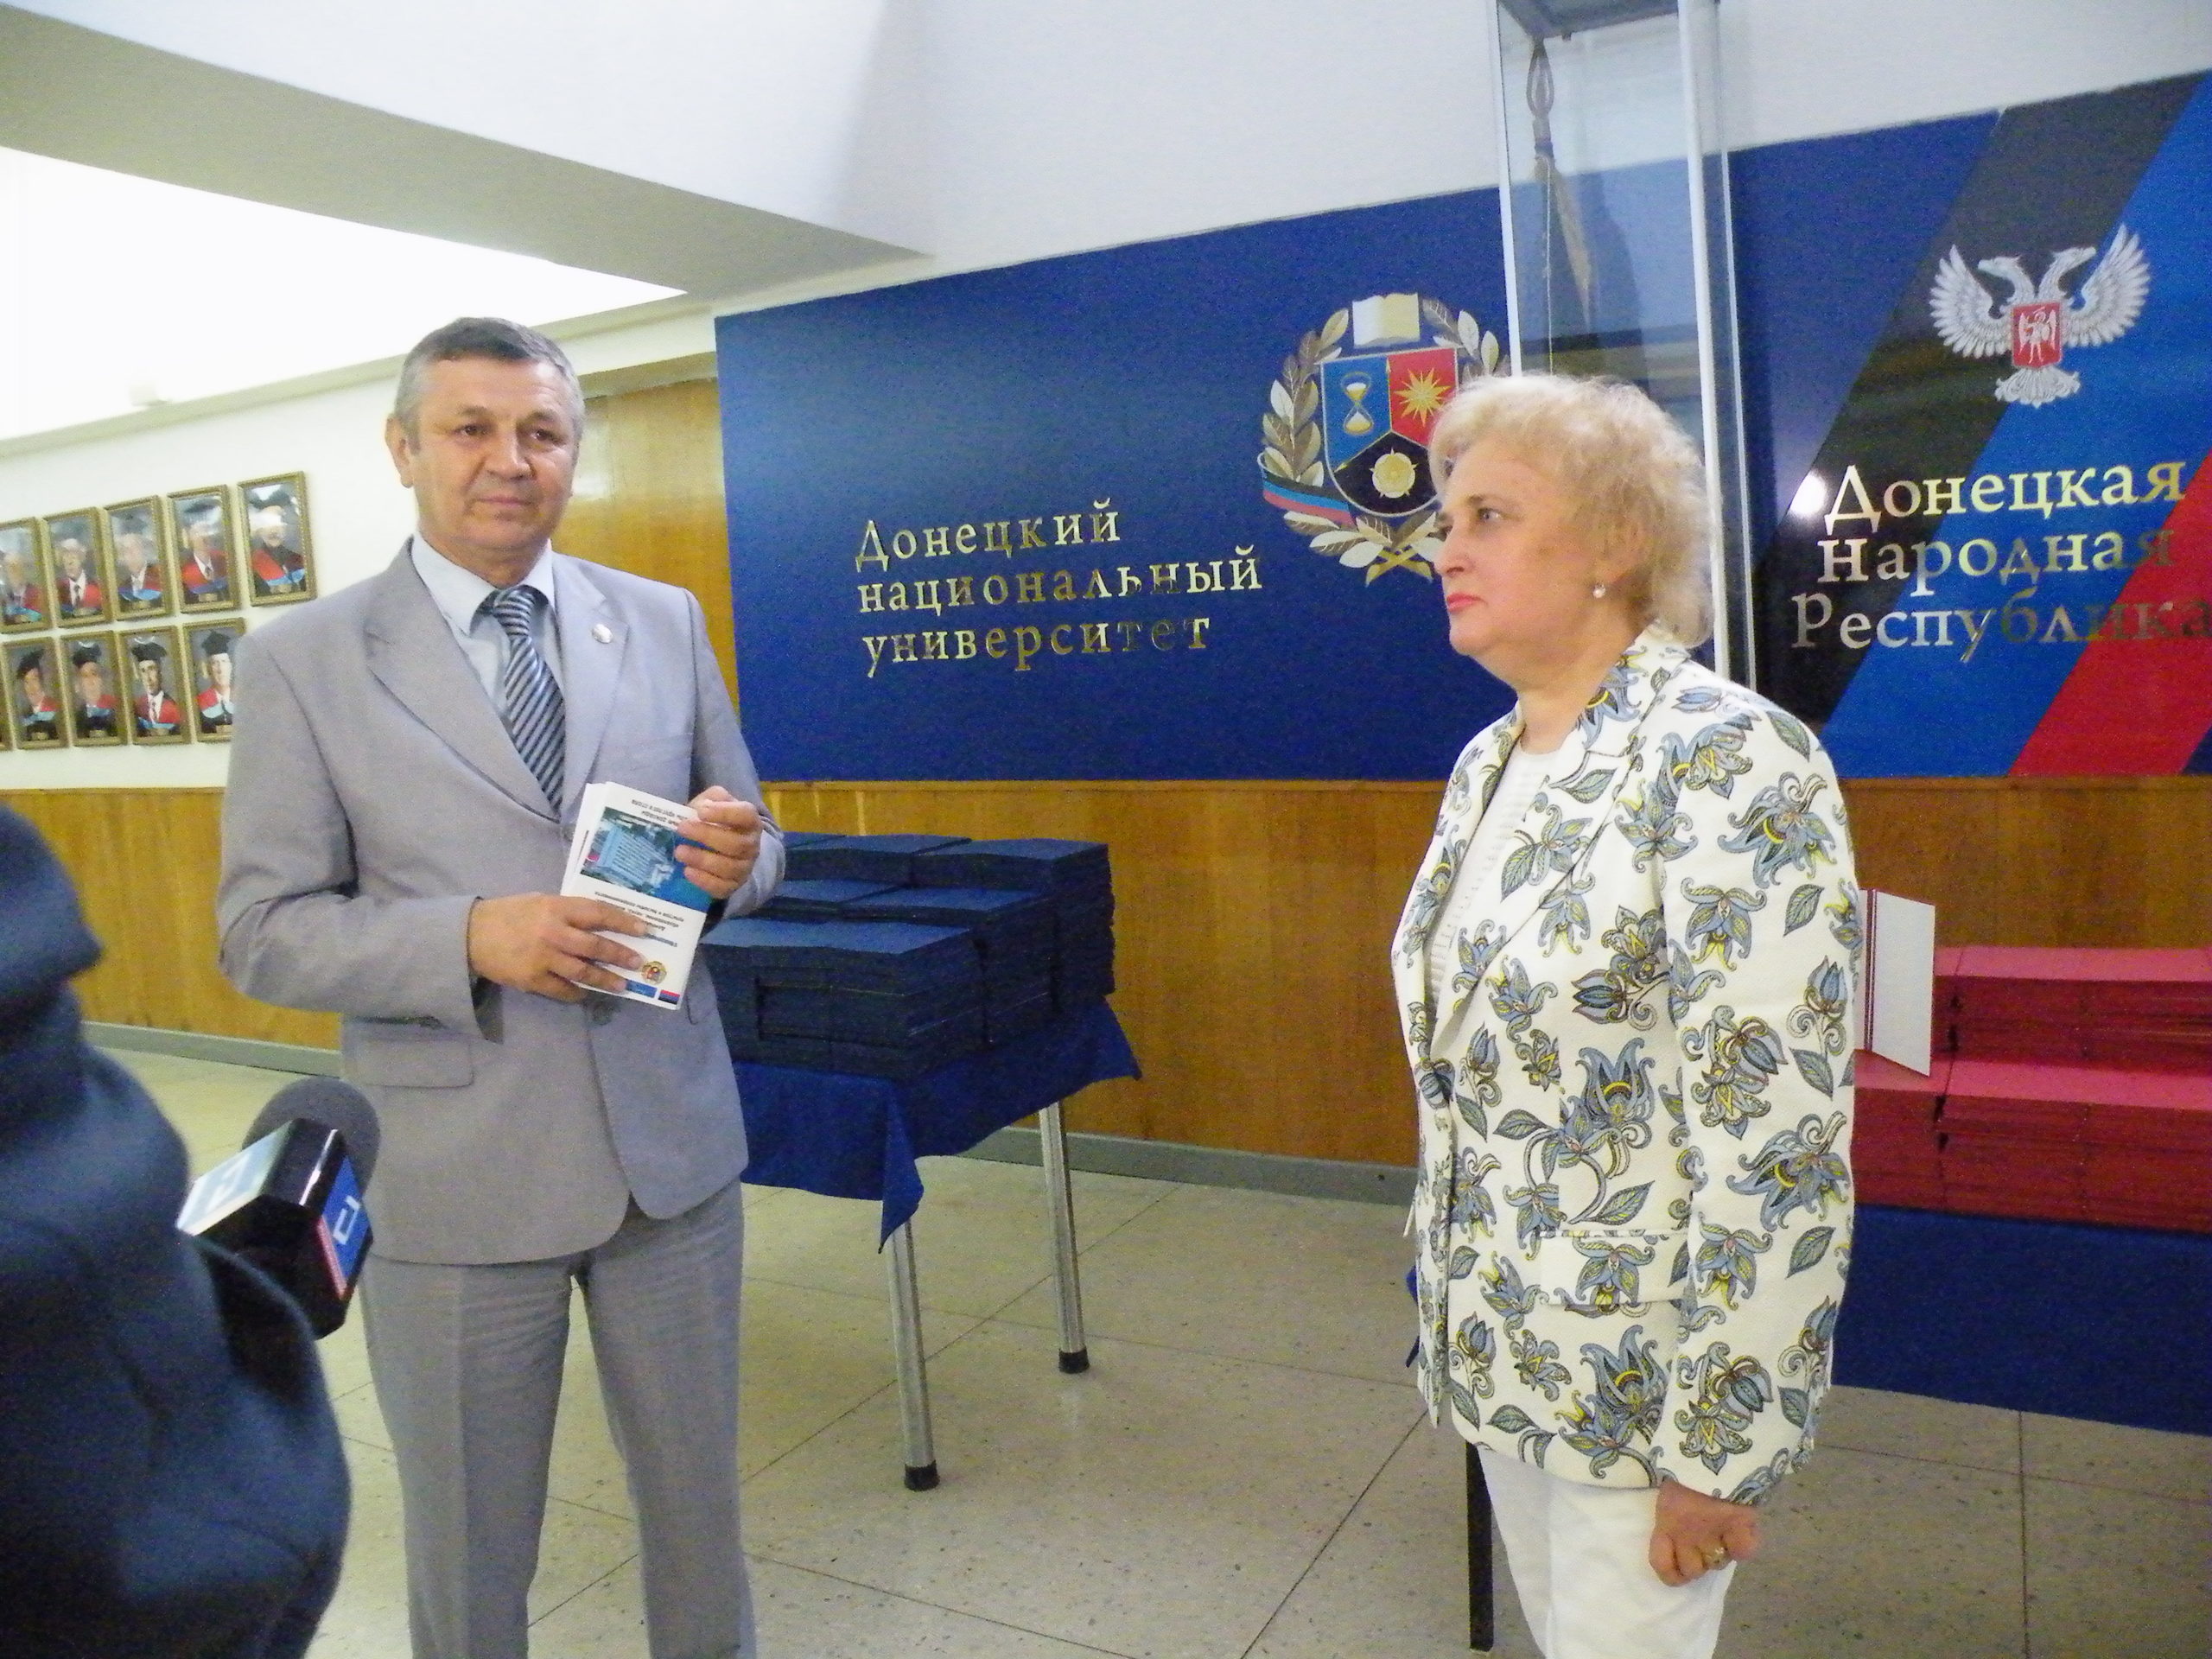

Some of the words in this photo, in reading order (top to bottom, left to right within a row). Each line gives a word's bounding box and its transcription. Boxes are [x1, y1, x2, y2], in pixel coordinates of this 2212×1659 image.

[855, 497, 1121, 572] Донецкий
[1823, 461, 2188, 536] Донецкая
[857, 544, 1263, 616] национальный
[862, 617, 1211, 678] университет
